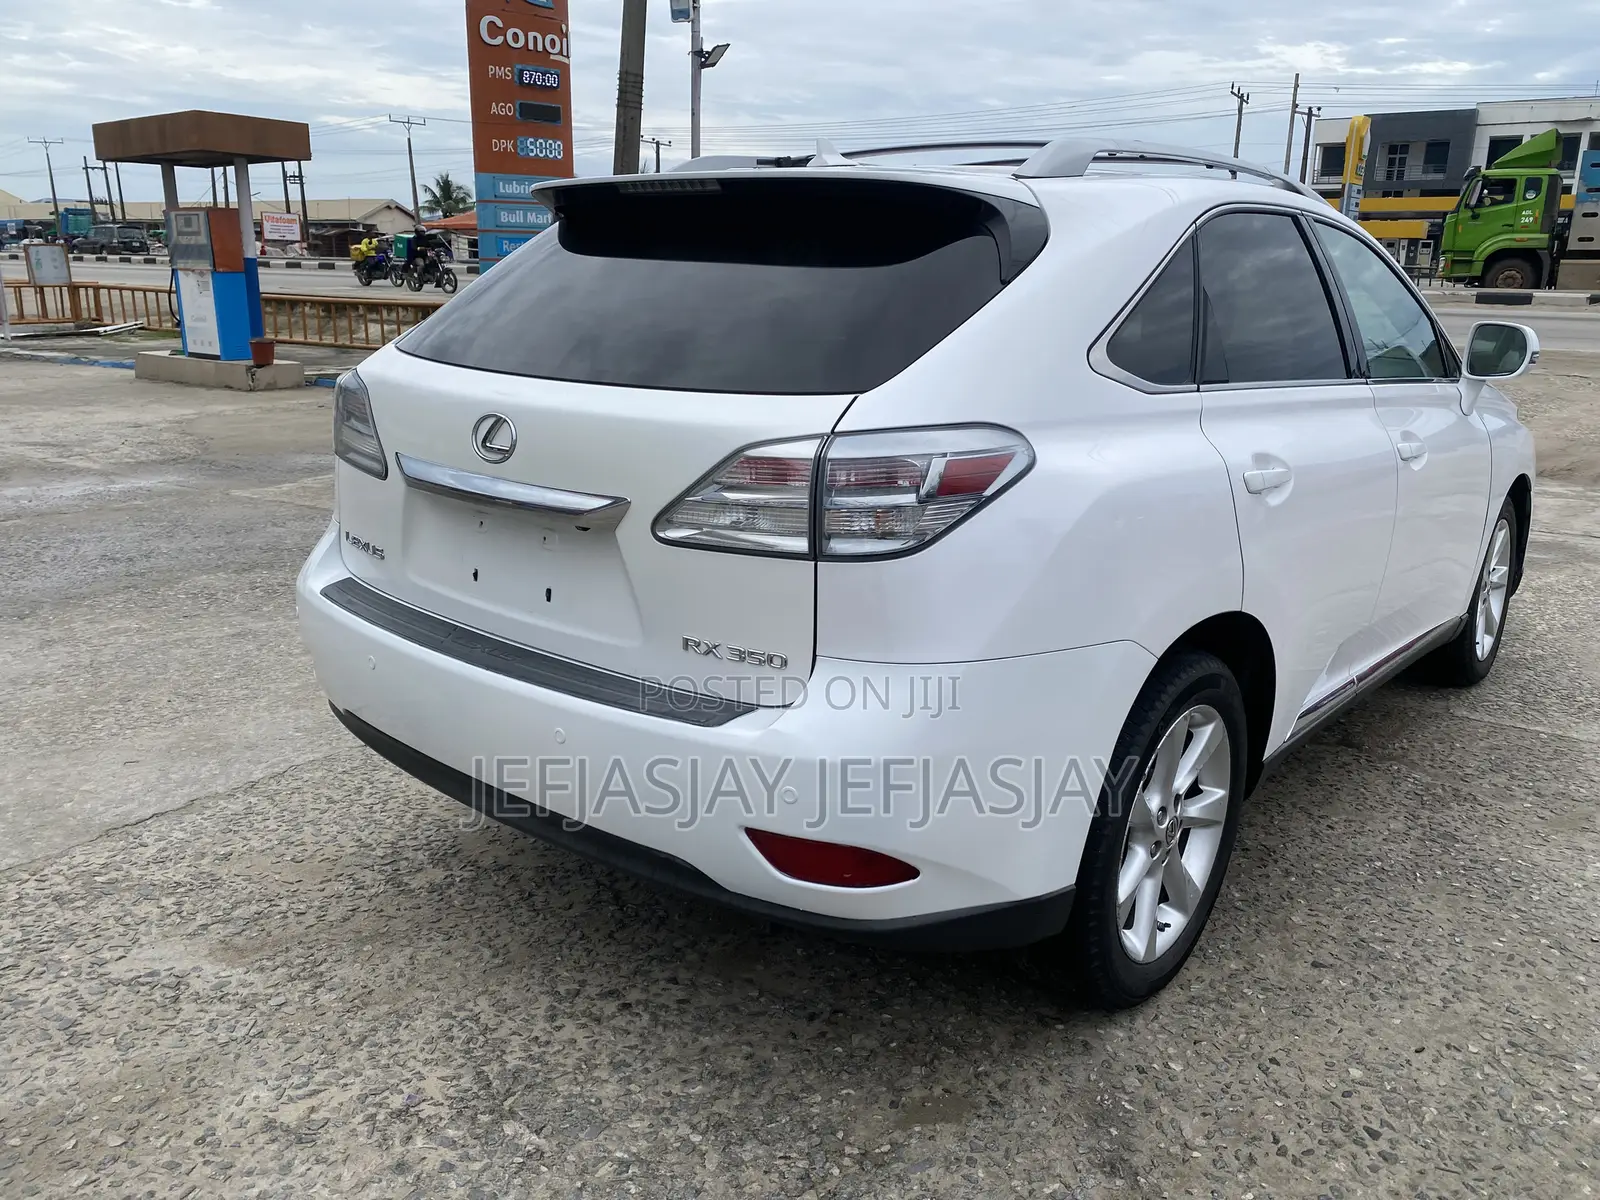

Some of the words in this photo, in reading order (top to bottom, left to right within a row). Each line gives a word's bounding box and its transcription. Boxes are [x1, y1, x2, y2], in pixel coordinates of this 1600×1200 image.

[488, 65, 512, 80] PMS
[522, 70, 559, 87] 870:00
[490, 102, 514, 116] AGO
[491, 139, 515, 153] DPK
[499, 181, 530, 195] Lubri
[500, 211, 523, 223] Bull
[526, 212, 552, 224] Mart
[344, 530, 386, 561] LEXUS
[681, 634, 723, 660] RX
[726, 644, 789, 671] 350
